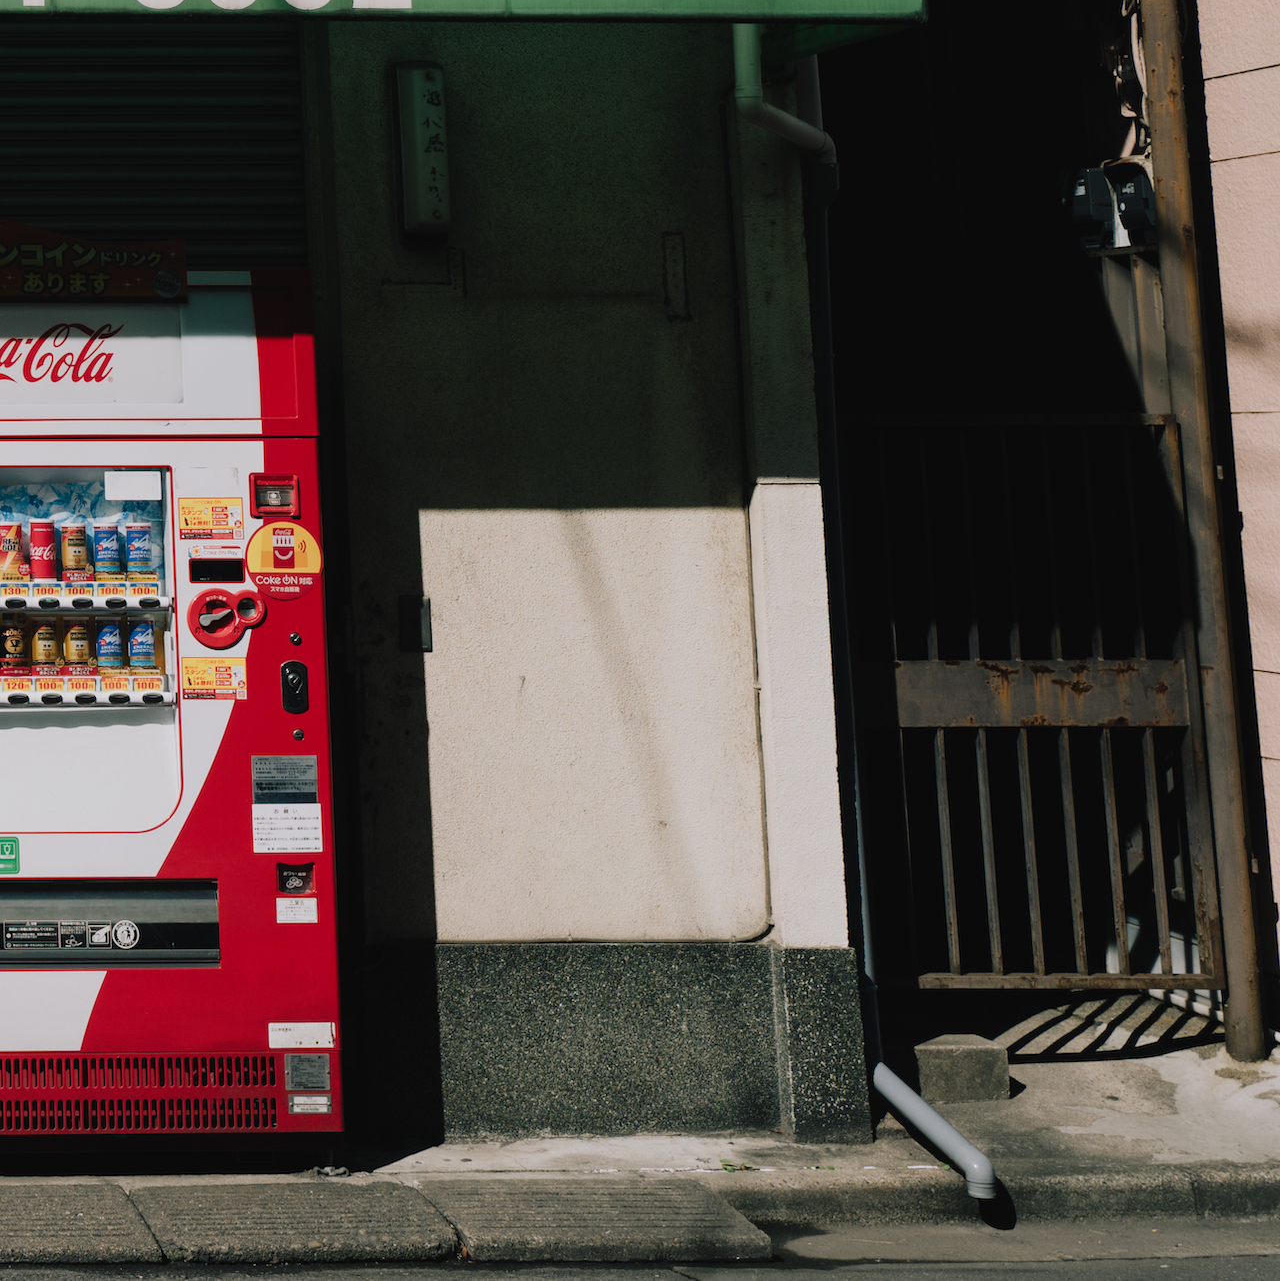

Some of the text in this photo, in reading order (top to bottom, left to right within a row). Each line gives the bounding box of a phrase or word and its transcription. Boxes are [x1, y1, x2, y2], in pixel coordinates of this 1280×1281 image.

[22, 271, 111, 295] あります
[256, 574, 313, 585] Coke ON 対応
